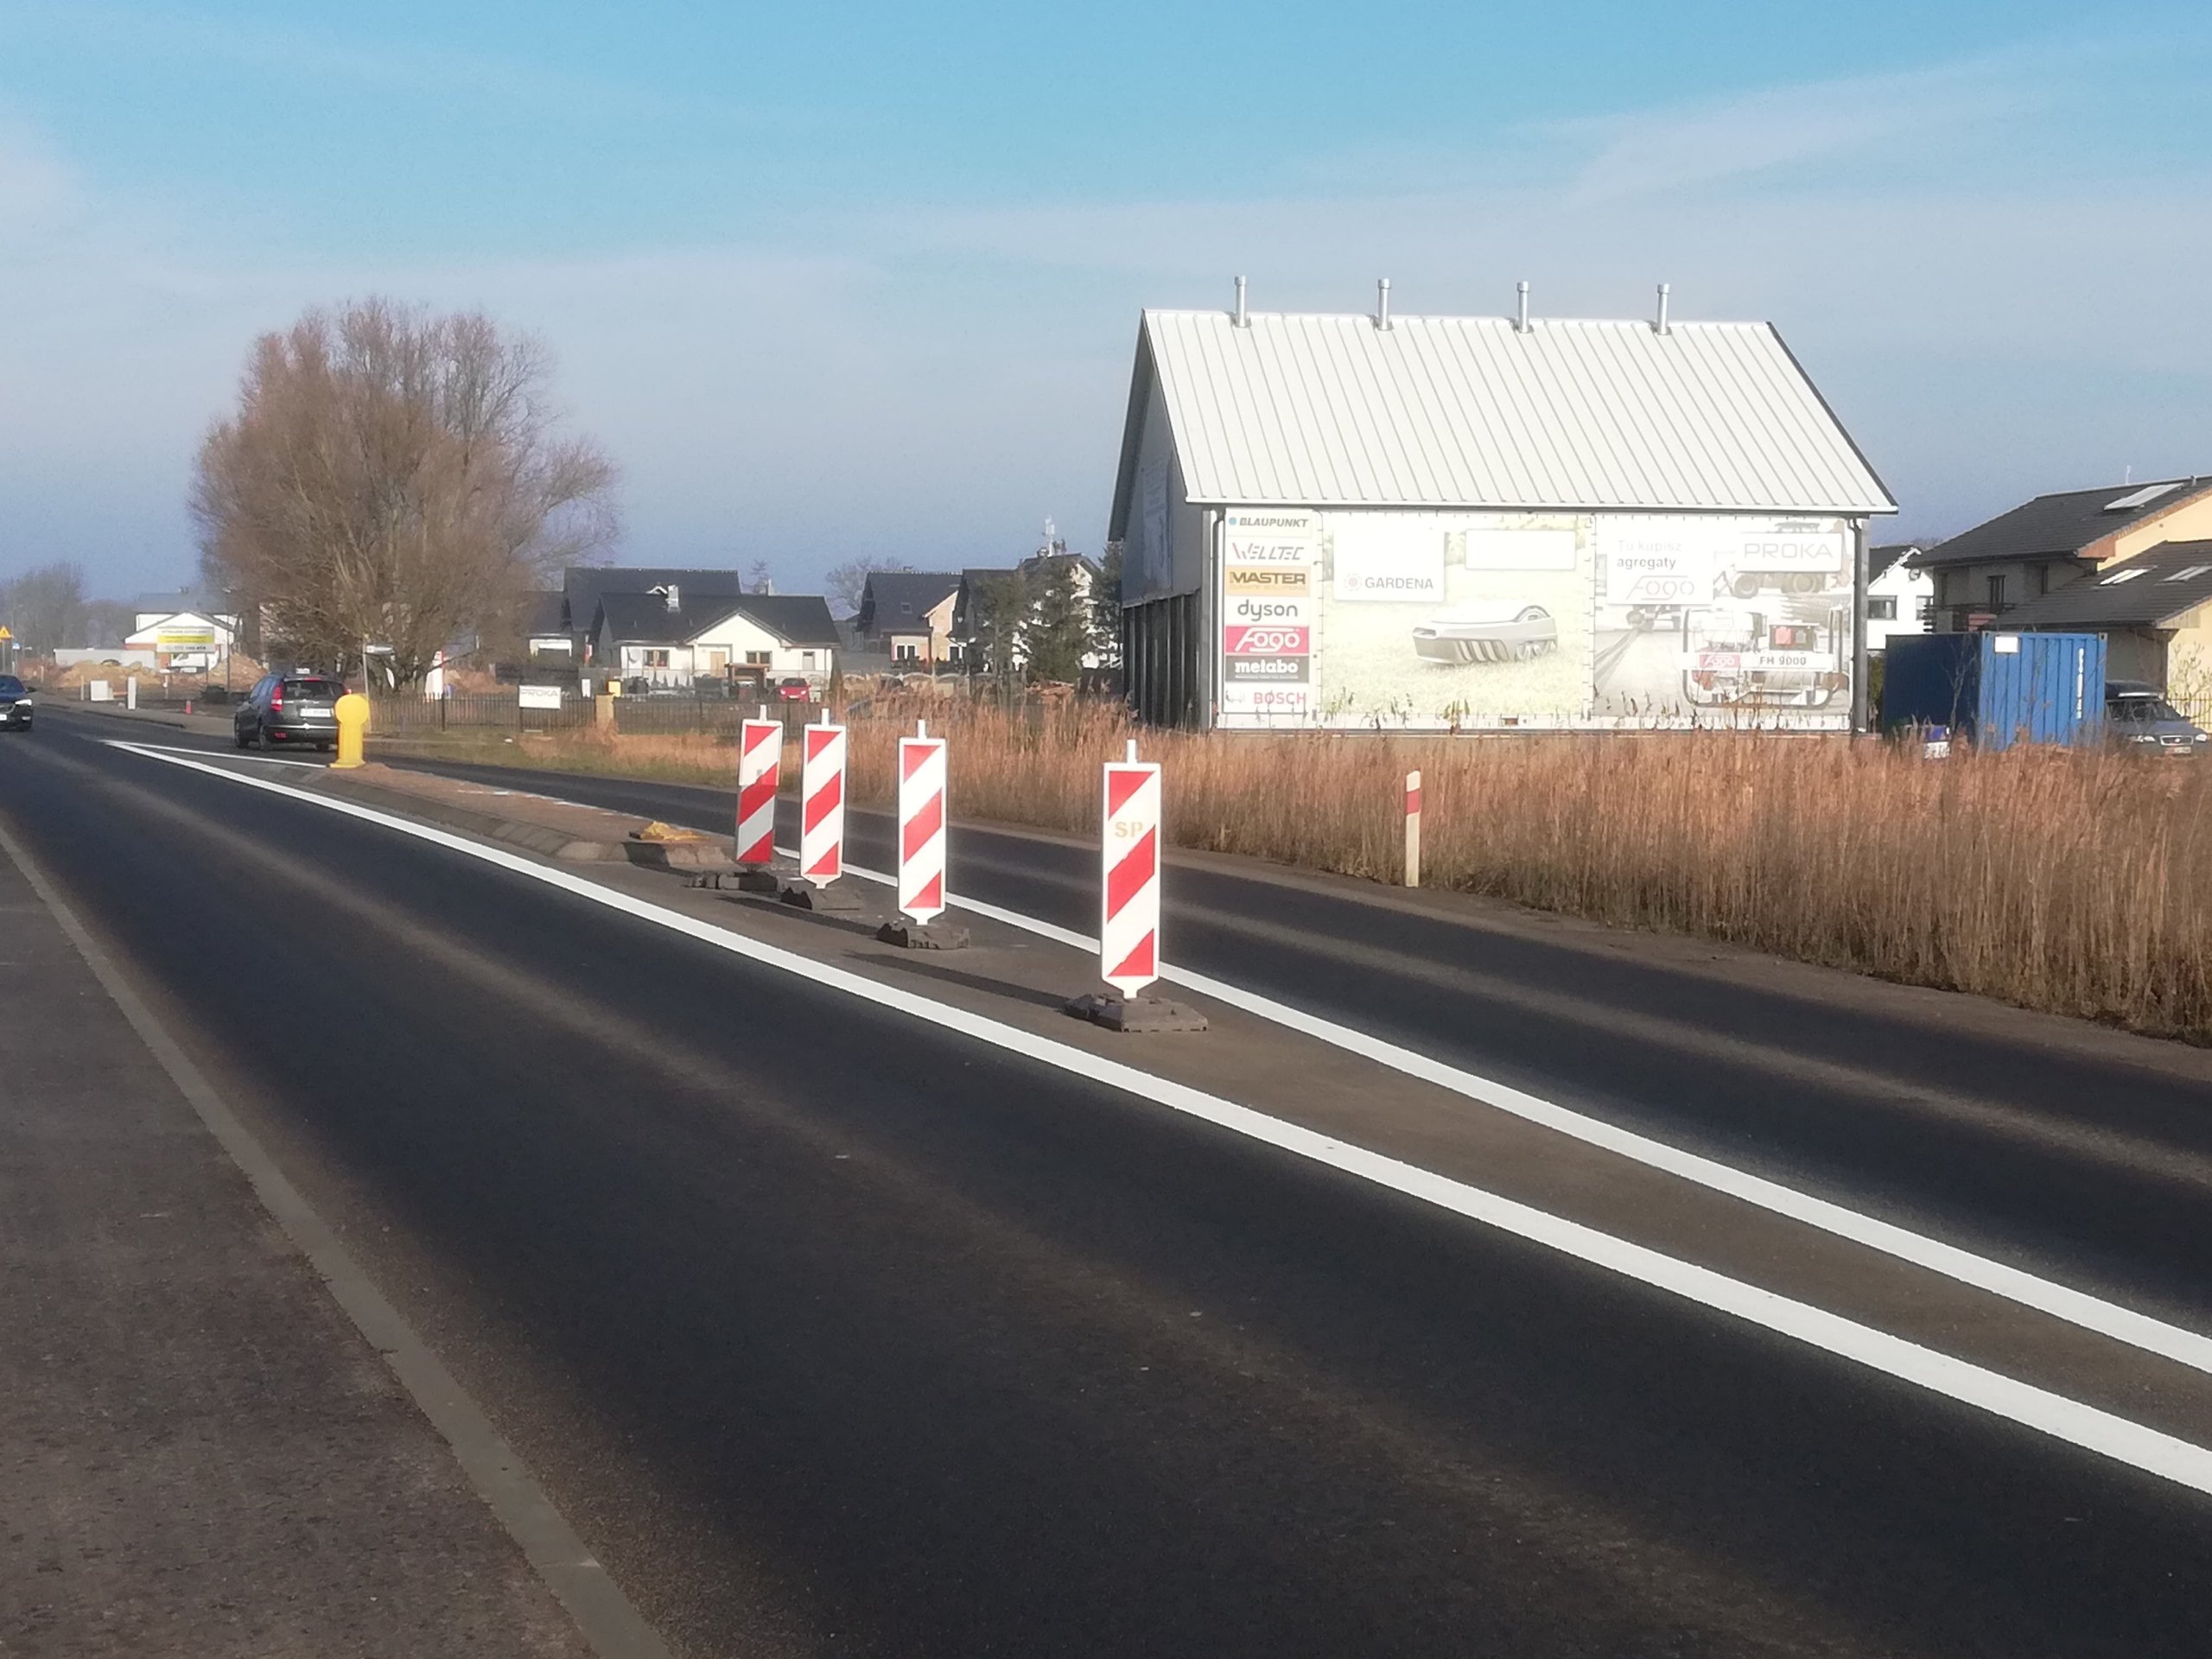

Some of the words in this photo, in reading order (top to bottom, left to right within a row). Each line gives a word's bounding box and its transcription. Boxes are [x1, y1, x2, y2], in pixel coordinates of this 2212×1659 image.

[1239, 517, 1309, 528] BLAUPUNKT
[1232, 542, 1305, 561] WELLTEC
[1744, 543, 1834, 559] PROKA
[1617, 556, 1677, 570] agregaty
[1229, 571, 1306, 585] MASTER
[1364, 576, 1434, 589] GARDENA
[1237, 599, 1299, 621] dyson
[1235, 658, 1299, 673] metabo
[1759, 657, 1775, 665] FH
[1778, 656, 1808, 665] 9000
[1253, 692, 1306, 704] BOSCH
[1114, 822, 1144, 838] SP
